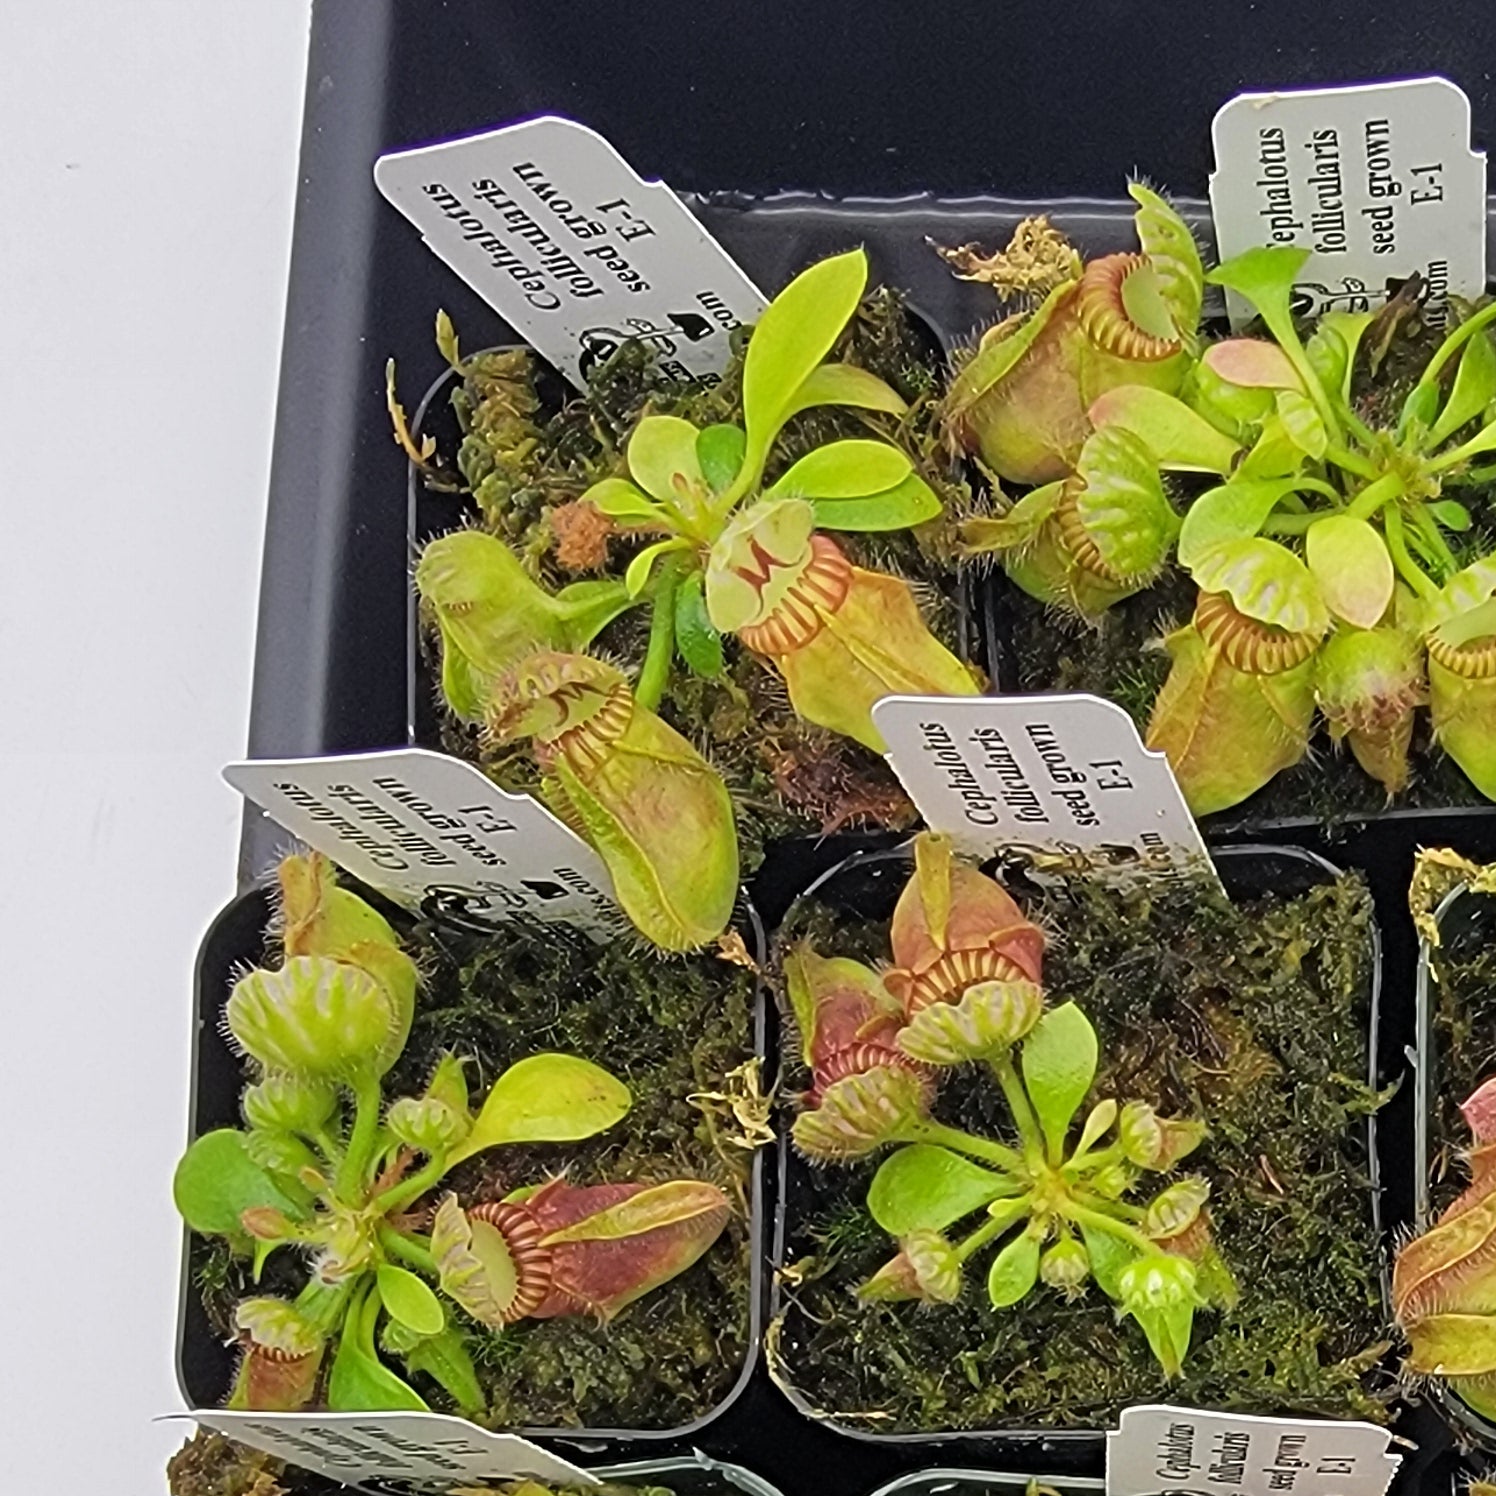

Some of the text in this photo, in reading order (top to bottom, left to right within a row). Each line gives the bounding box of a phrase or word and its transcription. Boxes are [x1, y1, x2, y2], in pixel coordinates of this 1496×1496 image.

[472, 178, 604, 298] follicularis
[513, 162, 651, 293] seed grown
[597, 198, 655, 242] E-1
[1257, 128, 1303, 249] ephalotus
[1304, 129, 1346, 253] follicularis
[1362, 119, 1402, 254] seed grown
[1411, 163, 1442, 205] E-1
[422, 183, 561, 311] Cephalotus
[920, 723, 999, 825] Cephalotus
[969, 728, 1049, 824] follicularis
[1025, 724, 1099, 827] seed grown
[1089, 760, 1133, 790] E-1
